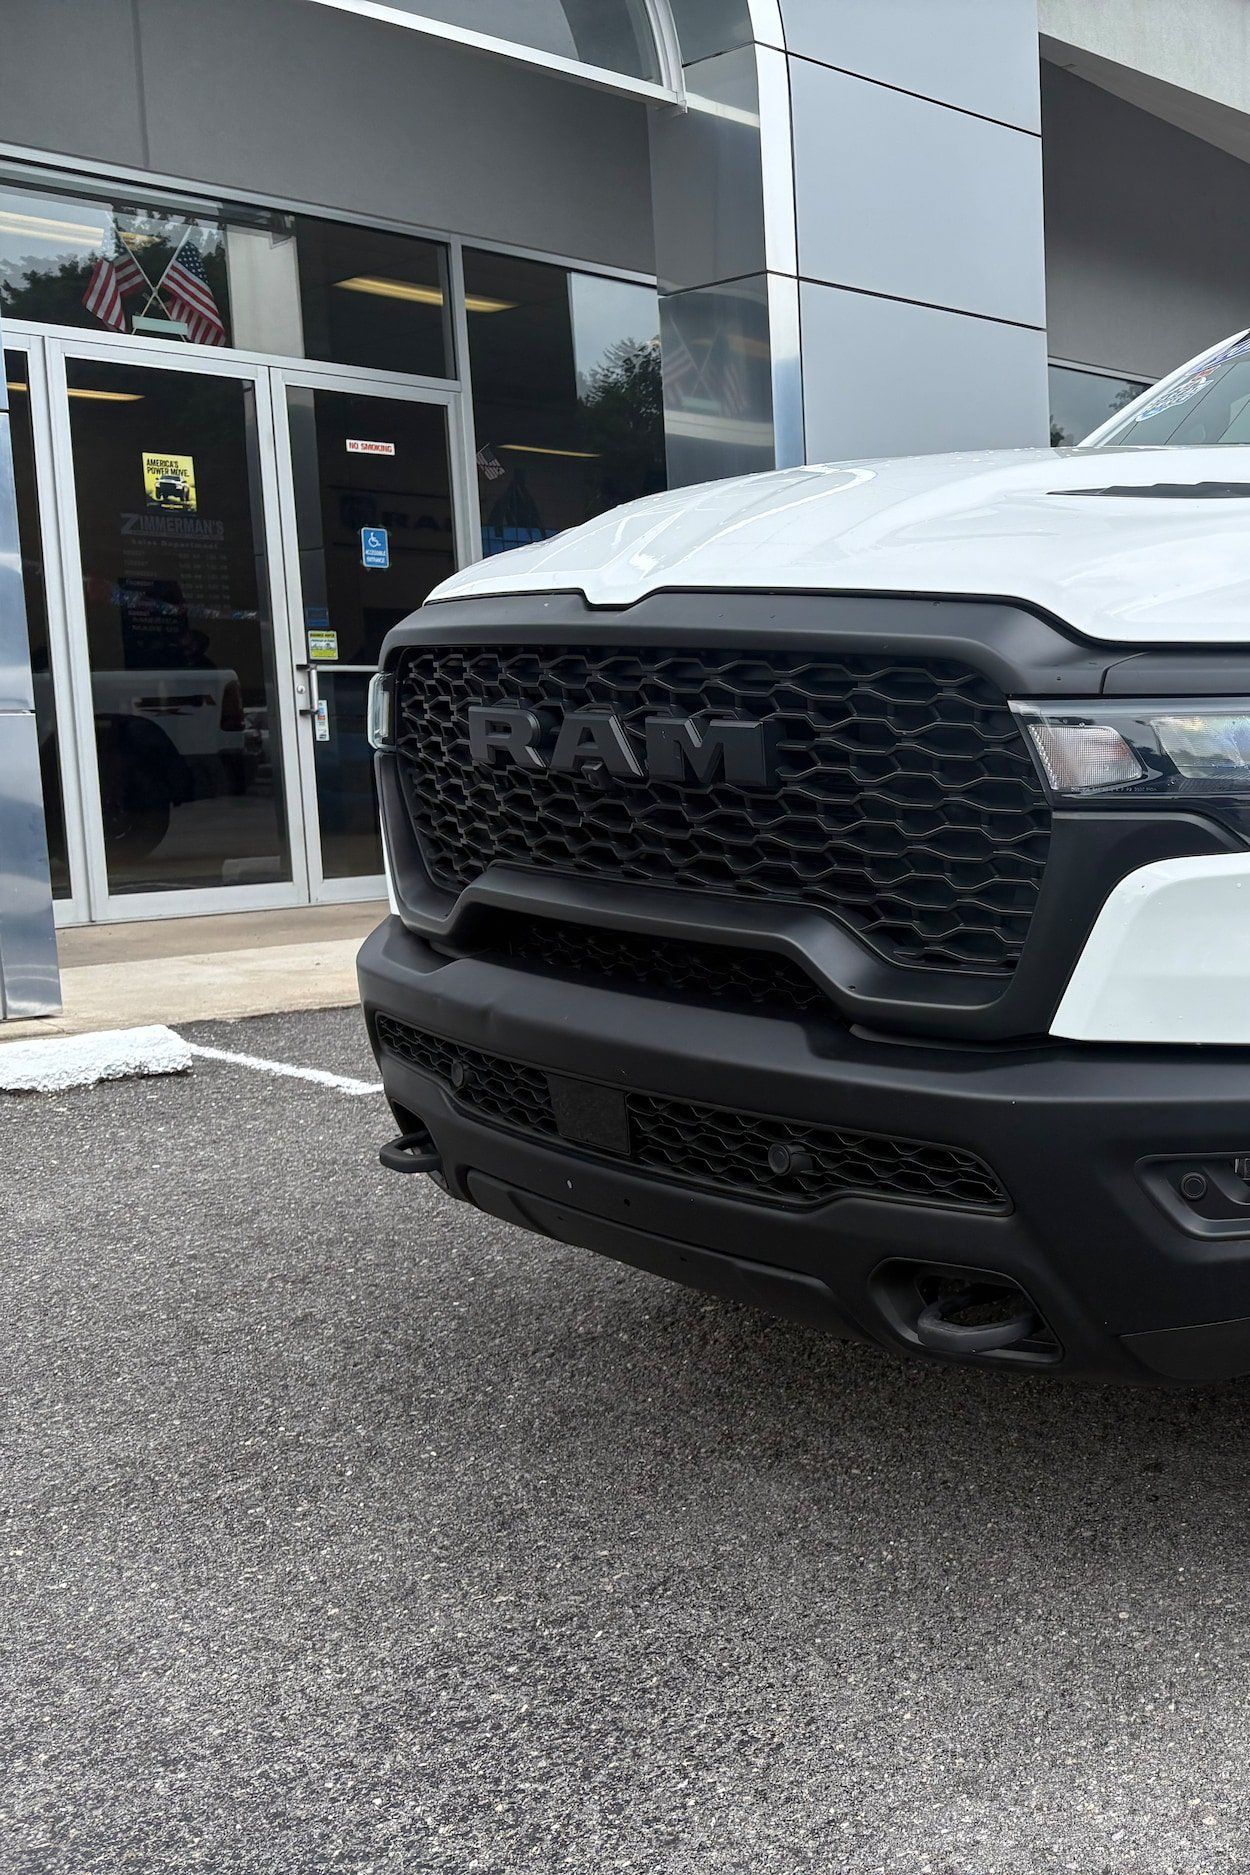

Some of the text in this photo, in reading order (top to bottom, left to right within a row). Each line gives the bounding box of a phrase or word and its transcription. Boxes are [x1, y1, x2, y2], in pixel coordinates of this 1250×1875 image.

[349, 441, 393, 453] NO SMOKING
[146, 458, 179, 468] AMERICA'S
[147, 466, 168, 475] POWER
[120, 512, 225, 537] ZIMMERMAN'S
[468, 705, 769, 787] RAM
